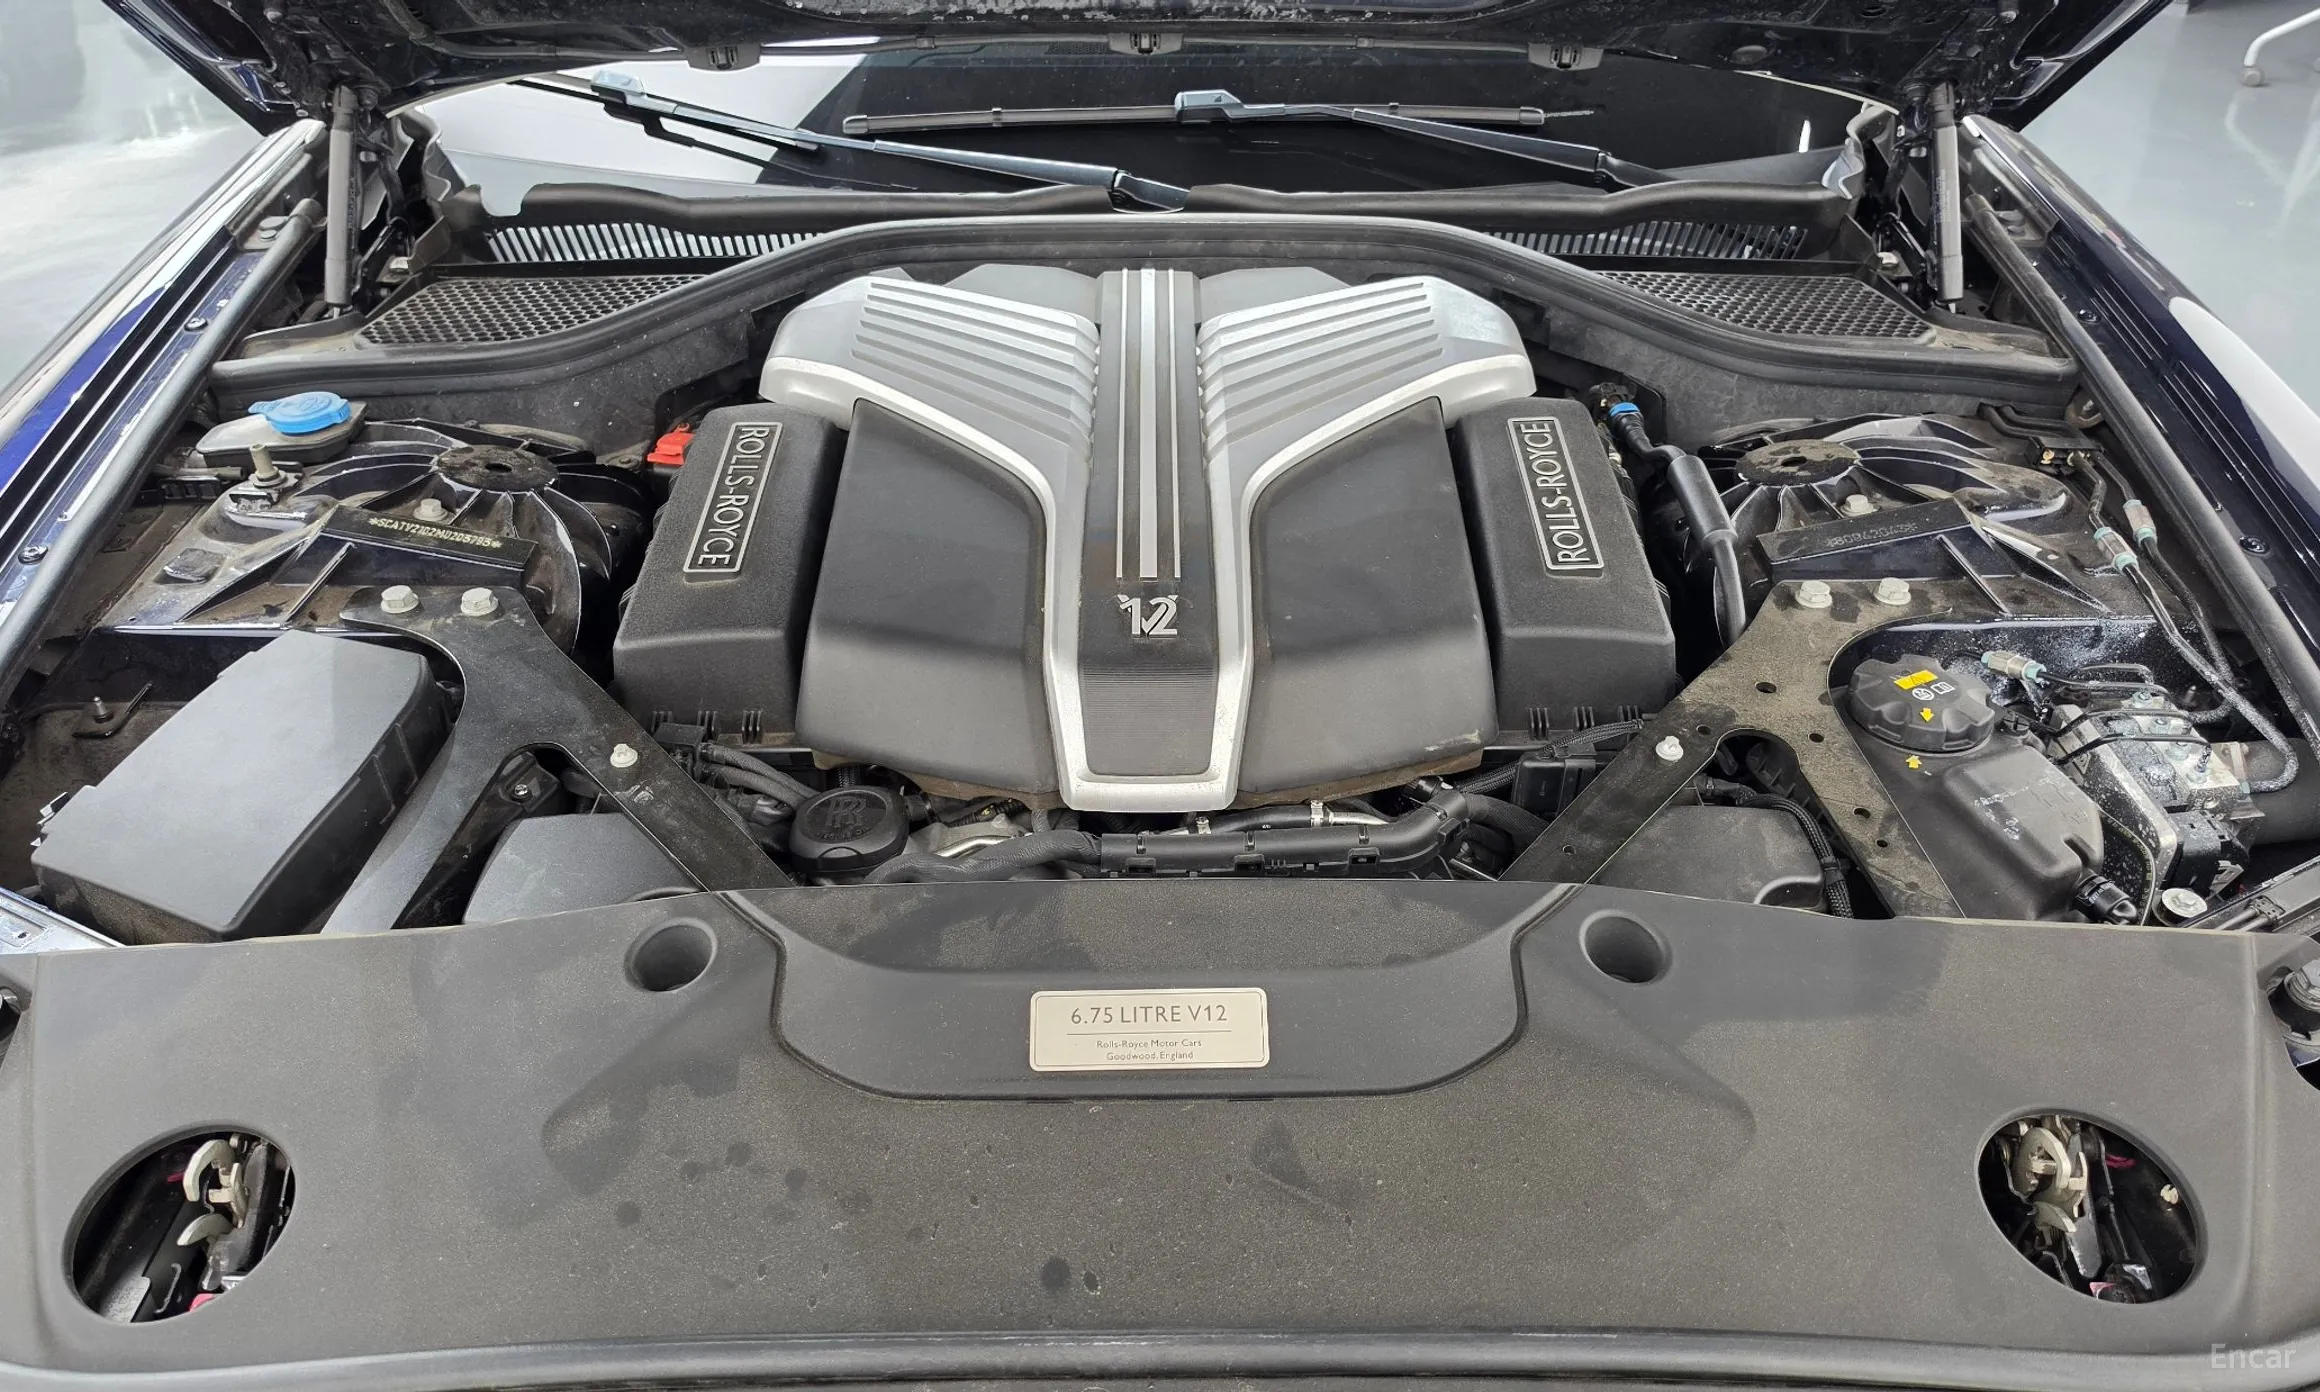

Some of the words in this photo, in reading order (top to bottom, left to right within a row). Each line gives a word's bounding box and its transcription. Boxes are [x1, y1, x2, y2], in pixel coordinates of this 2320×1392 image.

[698, 427, 770, 565] ROLLS-ROYCE
[1520, 422, 1591, 562] ROLLS-ROYCE
[1070, 1007, 1113, 1025] 6.75
[1120, 1006, 1181, 1023] LITRE
[1188, 1005, 1228, 1022] V12
[1097, 1040, 1148, 1050] Rolls-Royce
[1150, 1039, 1178, 1048] Motor
[1181, 1038, 1202, 1047] Cars
[1160, 1051, 1194, 1061] England
